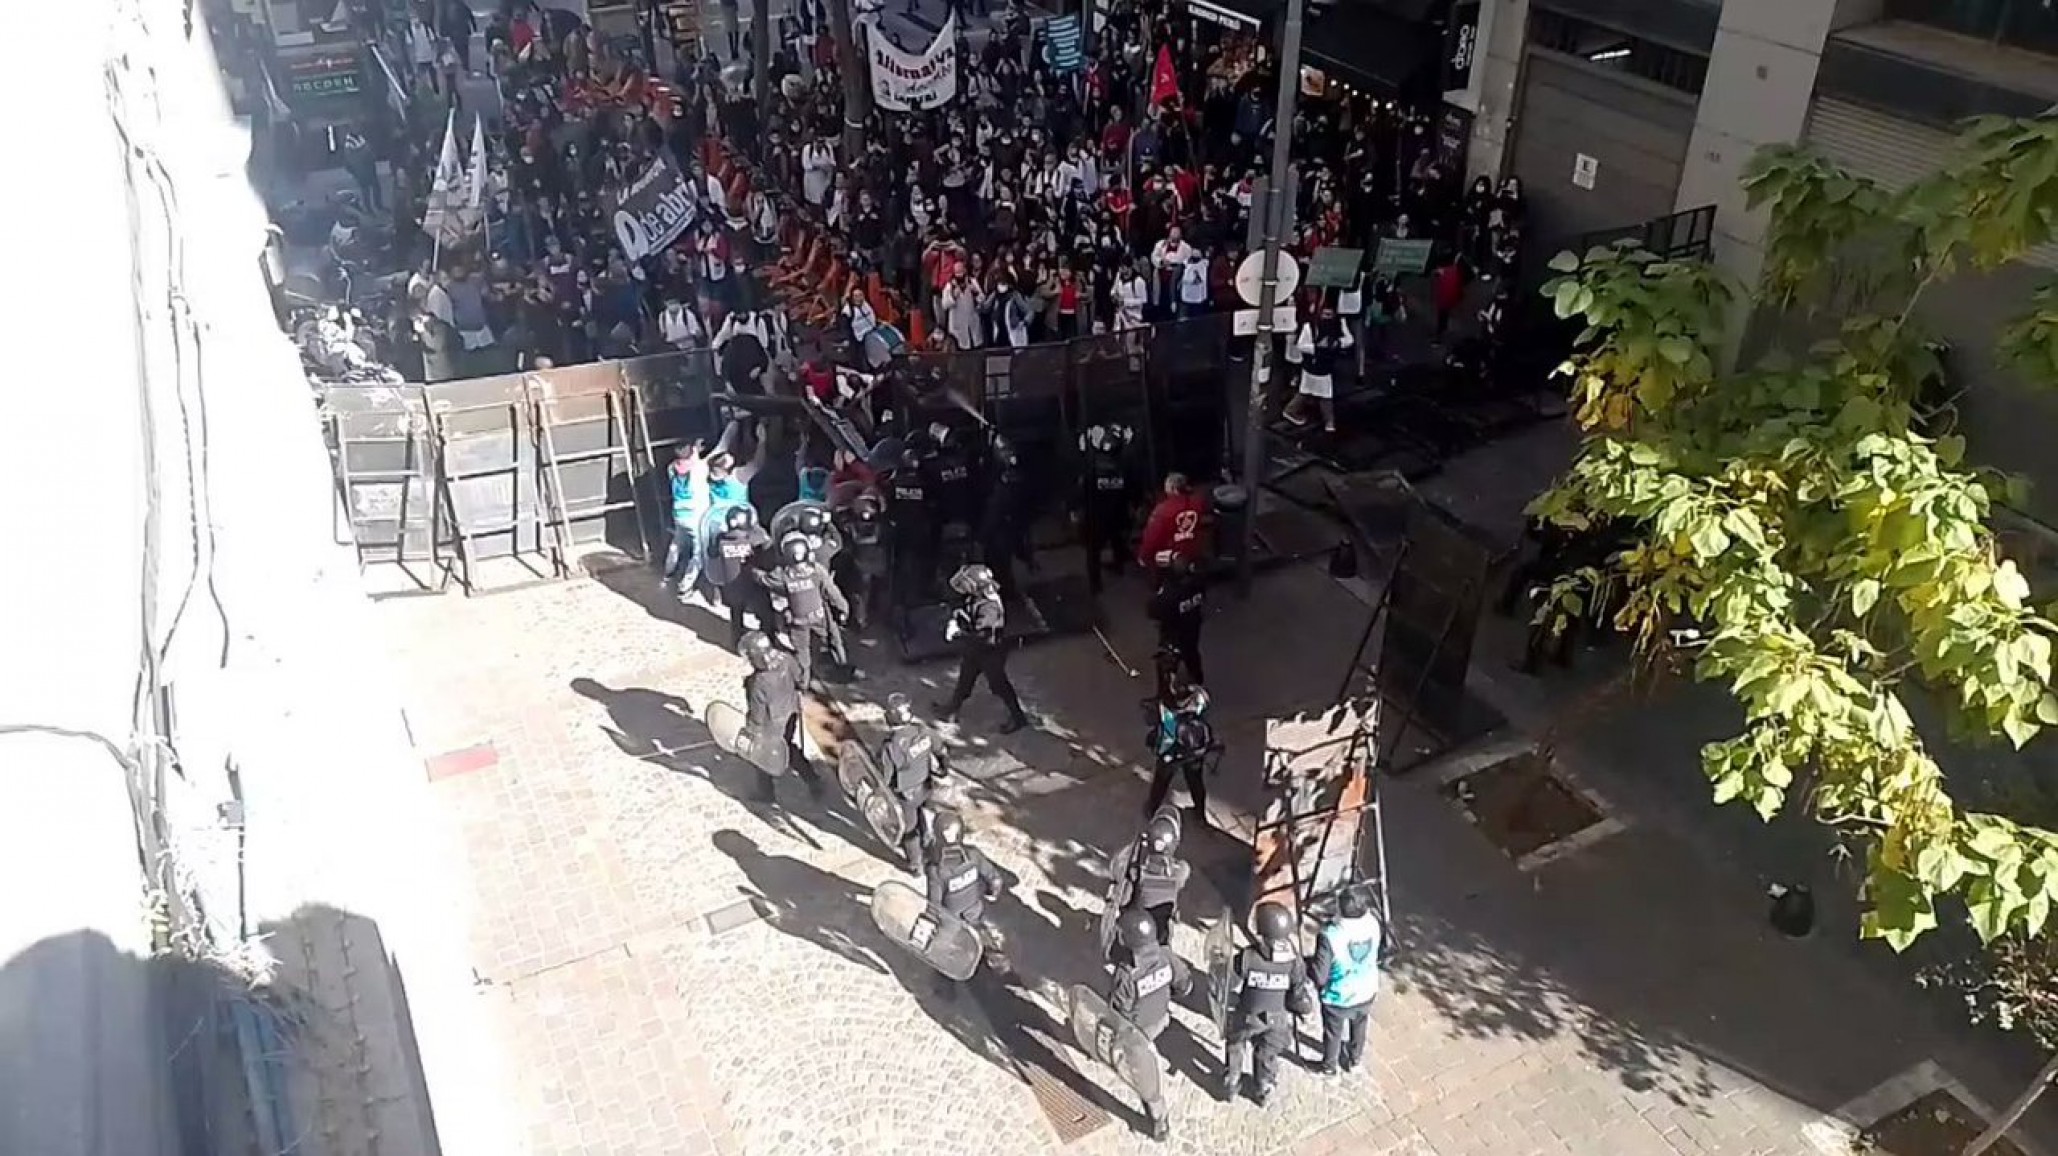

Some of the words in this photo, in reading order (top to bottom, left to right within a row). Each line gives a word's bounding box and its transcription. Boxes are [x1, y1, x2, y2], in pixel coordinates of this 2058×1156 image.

[638, 210, 665, 241] de
[947, 866, 978, 893] POLICIA
[1136, 963, 1173, 998] POLICIA
[1247, 970, 1290, 989] POLICIA
